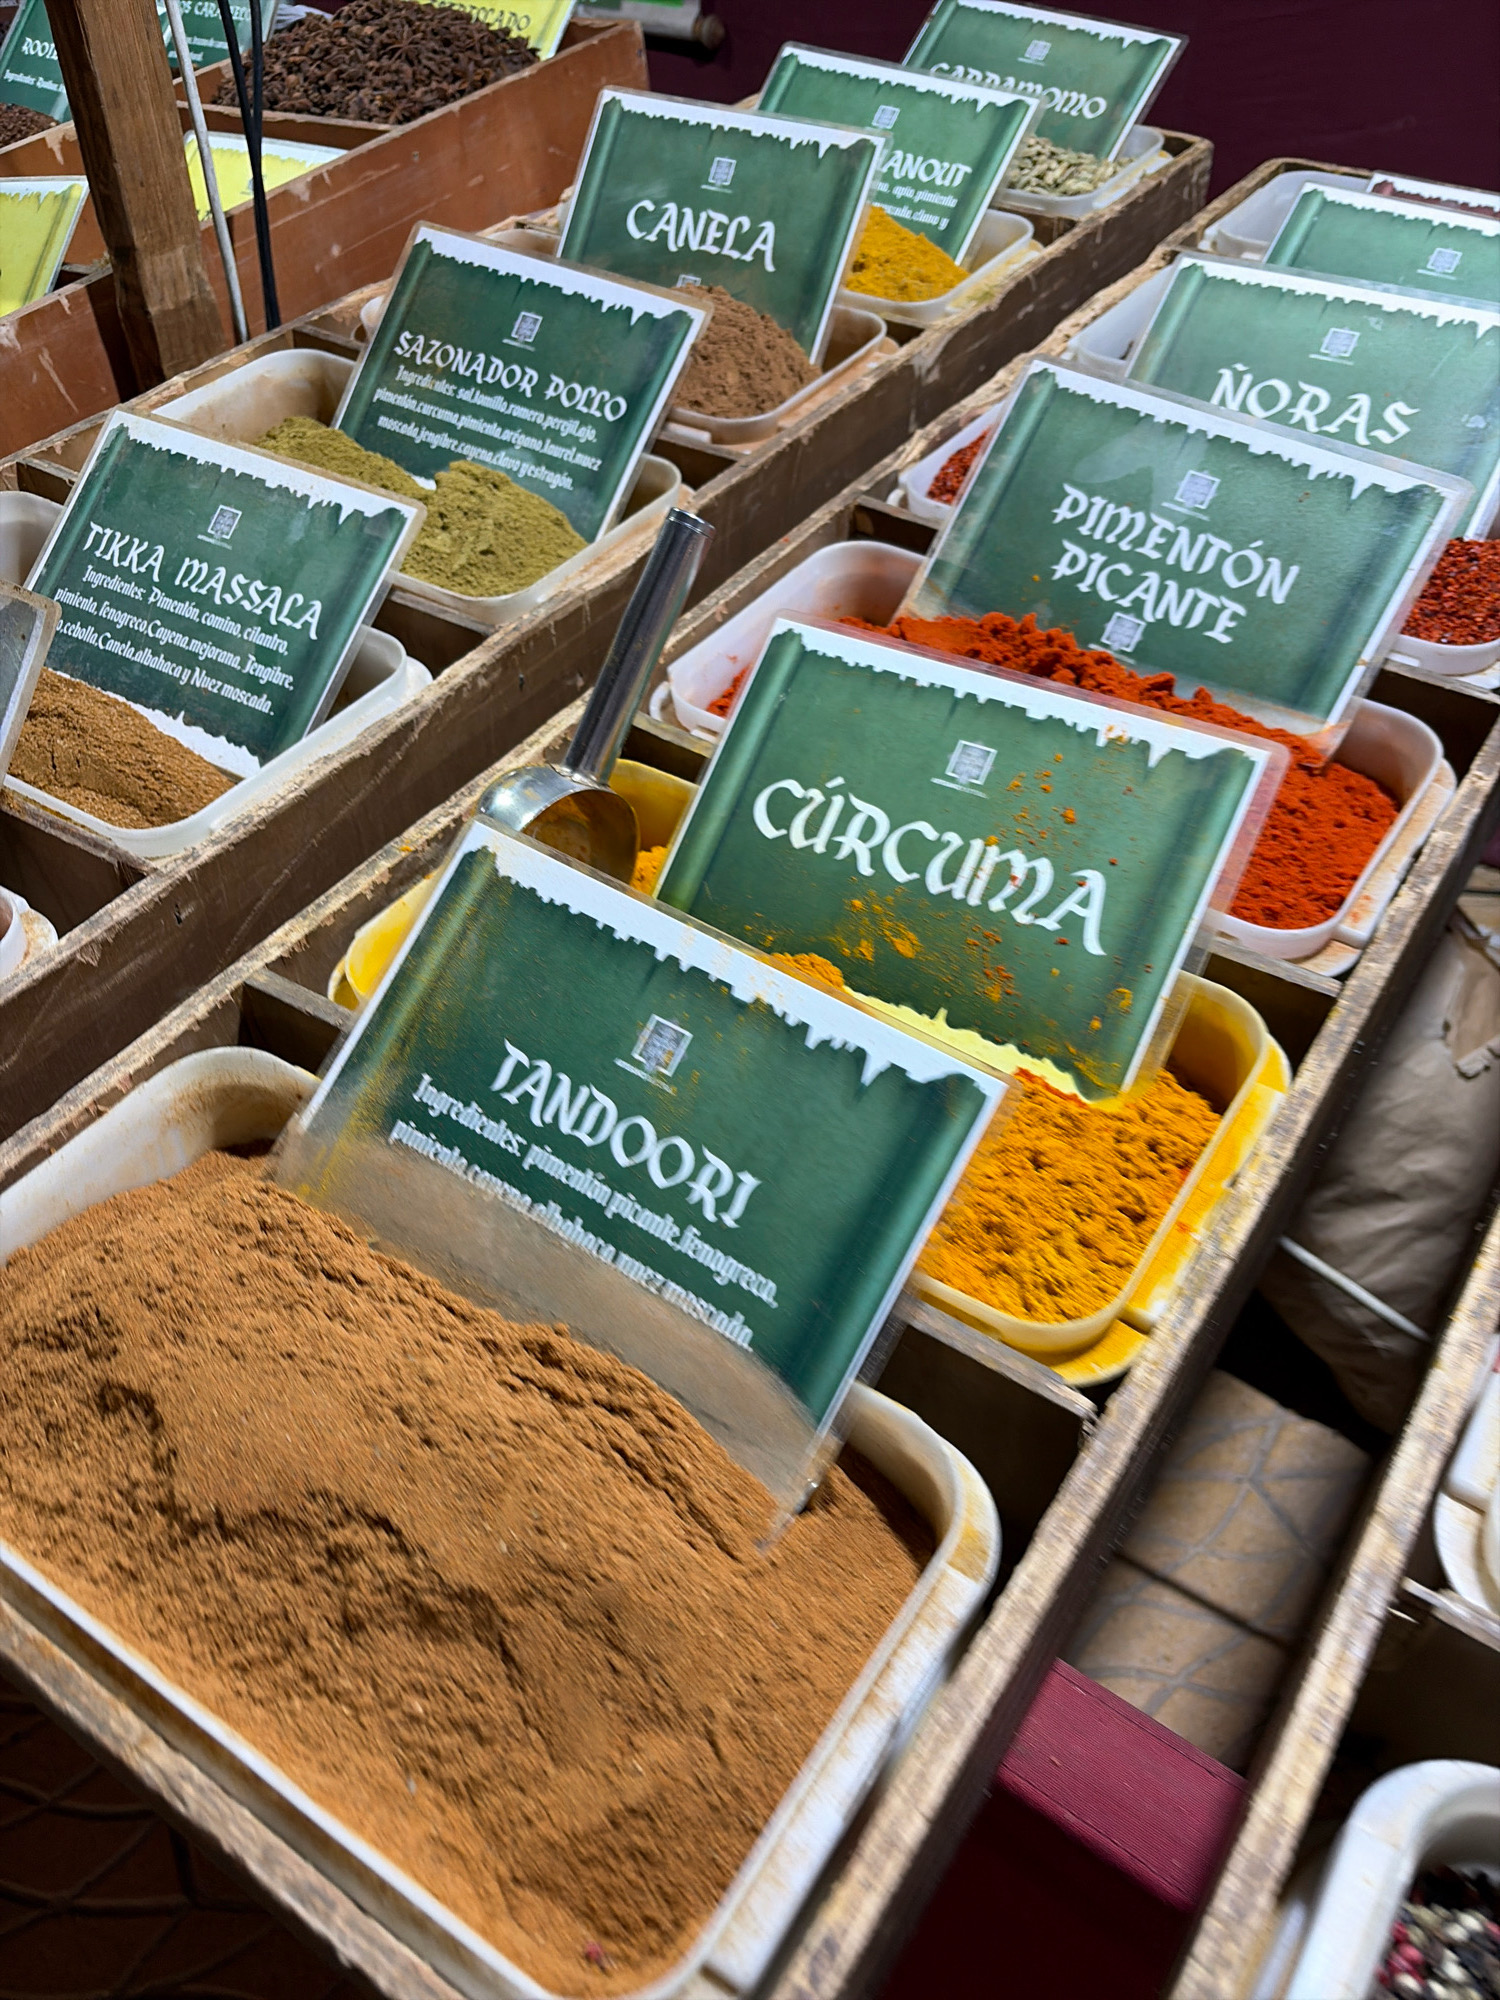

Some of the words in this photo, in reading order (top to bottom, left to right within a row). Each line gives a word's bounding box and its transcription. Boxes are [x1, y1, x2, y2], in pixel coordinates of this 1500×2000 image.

[626, 199, 776, 272] CANELA
[393, 330, 539, 398] SAZONADOR
[544, 373, 628, 422] POLLO
[1209, 363, 1421, 446] ÑORAS
[82, 521, 165, 582] TIKKA
[174, 556, 323, 640] MASSALA
[1050, 539, 1247, 644] PICANTE
[1051, 482, 1300, 605] PIMENTÓN
[54, 588, 98, 616] pimienta,
[242, 653, 295, 691] Jengibre,
[82, 564, 147, 601] Ingredientes:
[148, 586, 200, 623] Pimentón,
[201, 611, 242, 638] comino,
[243, 626, 289, 656] cilantro,
[179, 667, 192, 686] y
[190, 666, 223, 694] Nuez
[752, 776, 1107, 956] CÚRCUMA
[489, 1037, 762, 1229] TANDOORI
